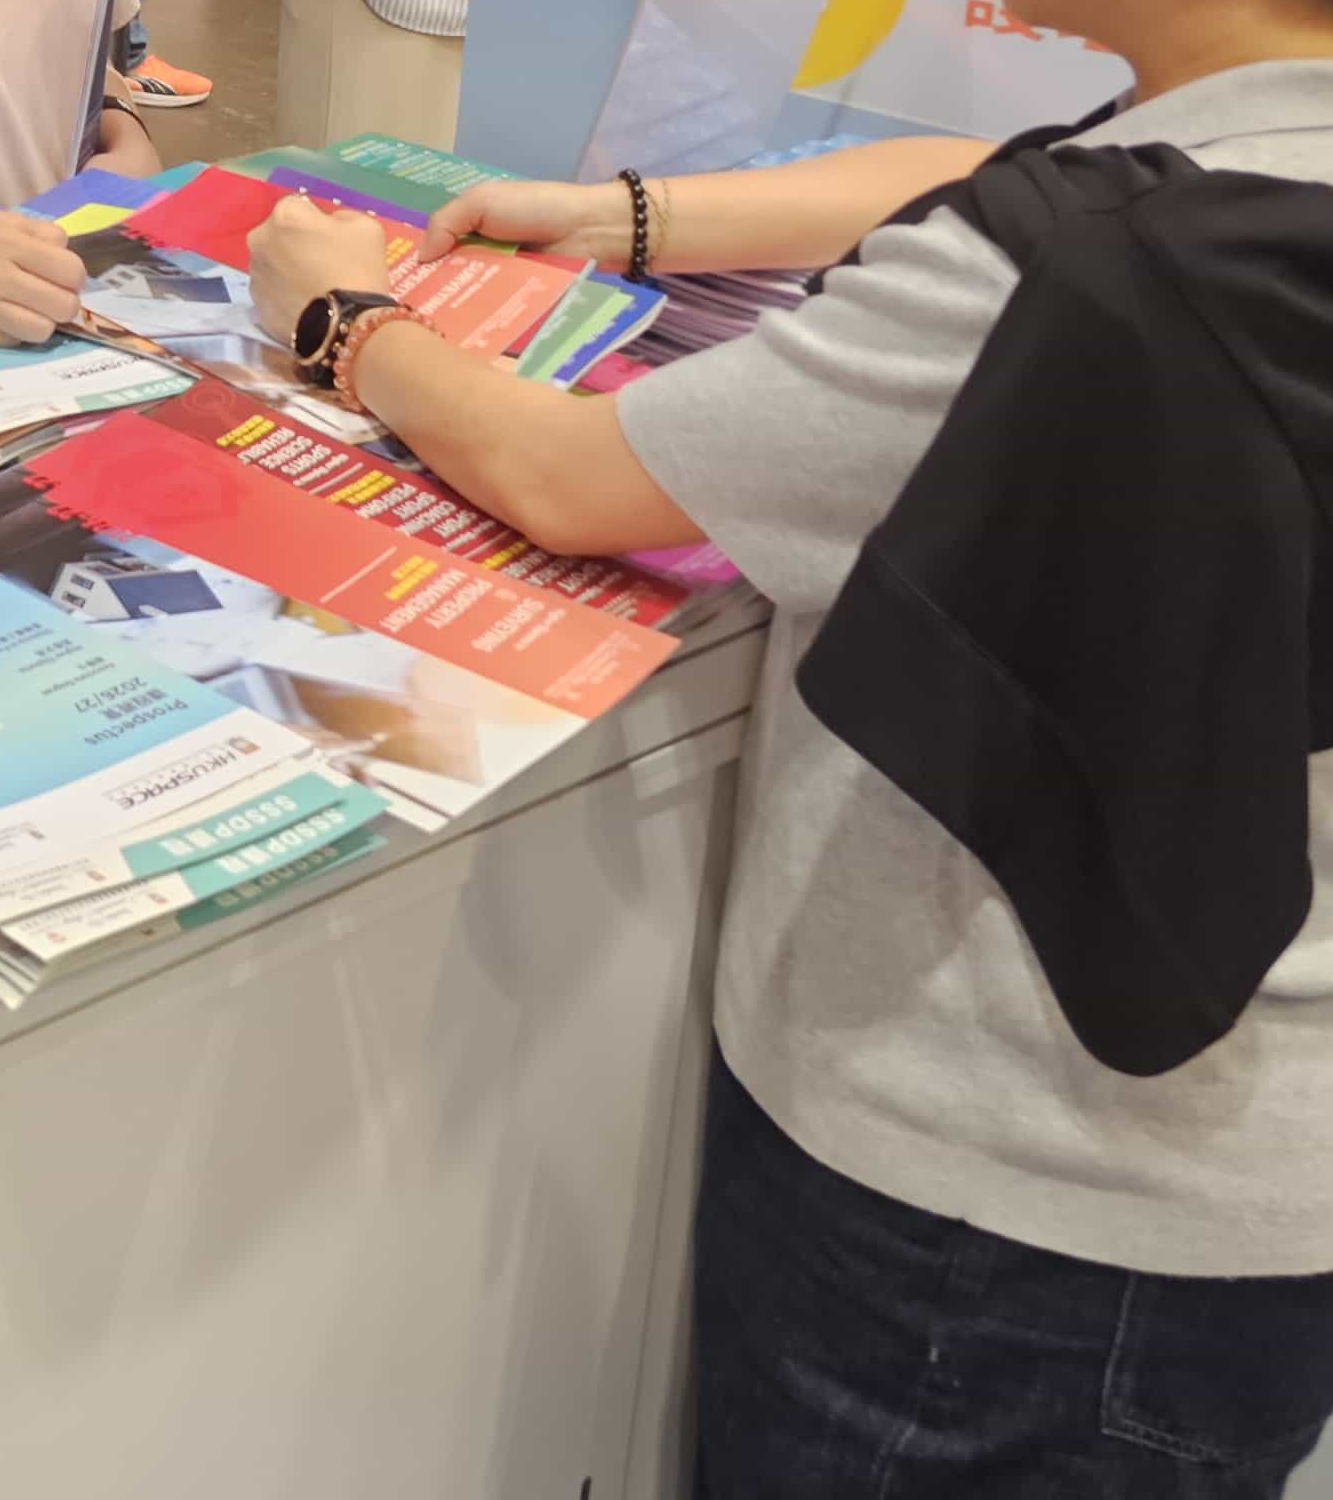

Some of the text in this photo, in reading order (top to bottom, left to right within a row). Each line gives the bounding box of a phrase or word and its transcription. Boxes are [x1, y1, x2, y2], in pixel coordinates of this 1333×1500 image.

[258, 435, 314, 469] SCIENCE
[280, 443, 332, 476] SPORTS
[392, 491, 437, 520] SPORT
[380, 567, 468, 633] MANAGEMENT
[424, 576, 494, 629] PROPERTY
[471, 597, 545, 653] SURVEYING
[74, 675, 148, 714] 2026/27
[84, 698, 189, 746] Prospectus
